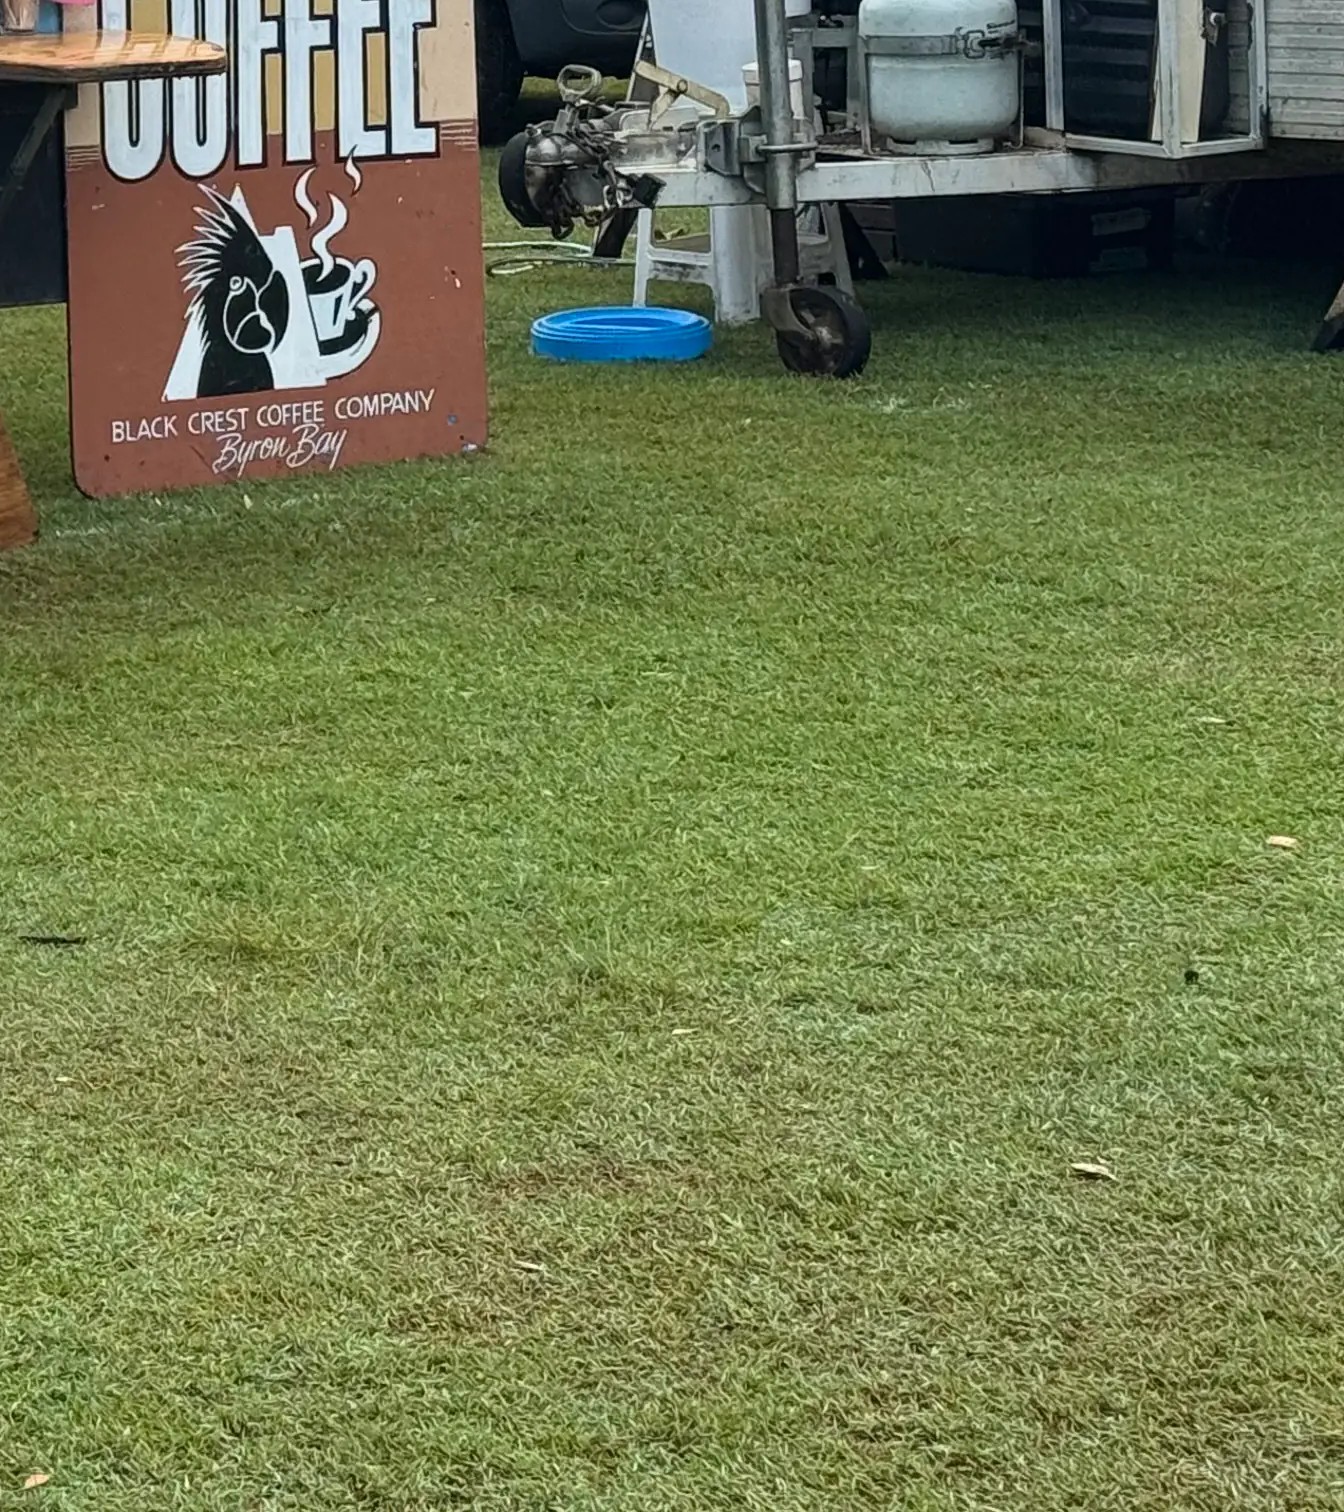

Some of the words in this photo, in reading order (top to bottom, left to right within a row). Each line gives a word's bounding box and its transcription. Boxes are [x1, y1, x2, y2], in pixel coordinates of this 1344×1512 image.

[111, 414, 178, 444] BLACK
[187, 407, 250, 436] CREST
[255, 399, 325, 428] COFFEE
[333, 388, 436, 420] COMPANY
[212, 432, 290, 478] Byron
[285, 422, 349, 471] Bay
